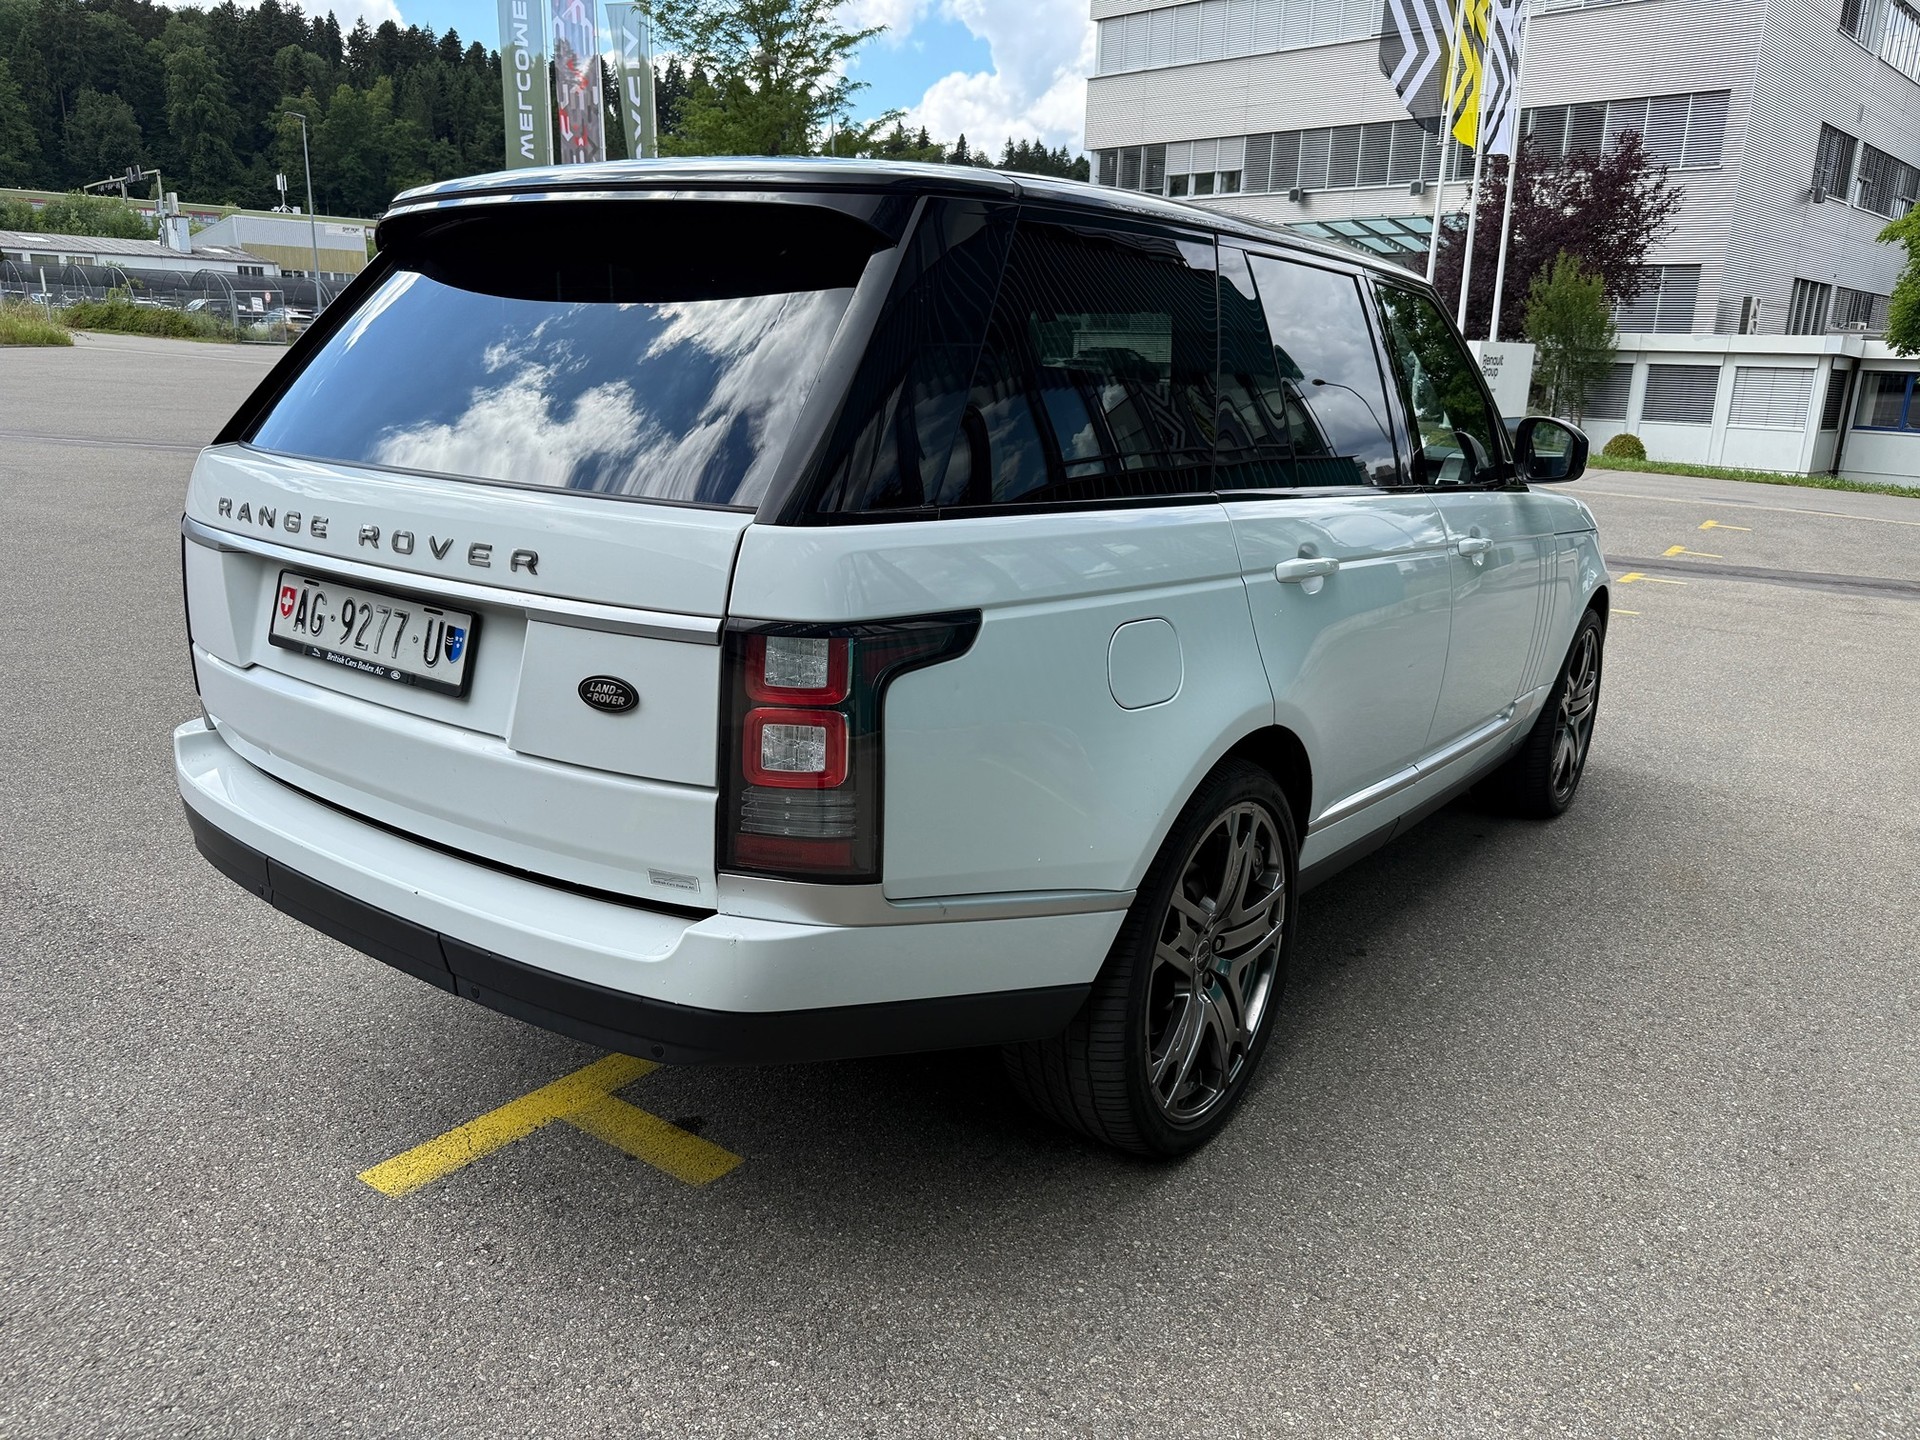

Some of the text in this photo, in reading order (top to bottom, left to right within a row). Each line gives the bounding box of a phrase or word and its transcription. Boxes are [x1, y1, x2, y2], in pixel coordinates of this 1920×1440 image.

[1482, 354, 1504, 366] Renault
[1481, 366, 1499, 379] Group
[218, 497, 539, 575] RANGE ROVER
[326, 652, 385, 675] British Cars Baden AG
